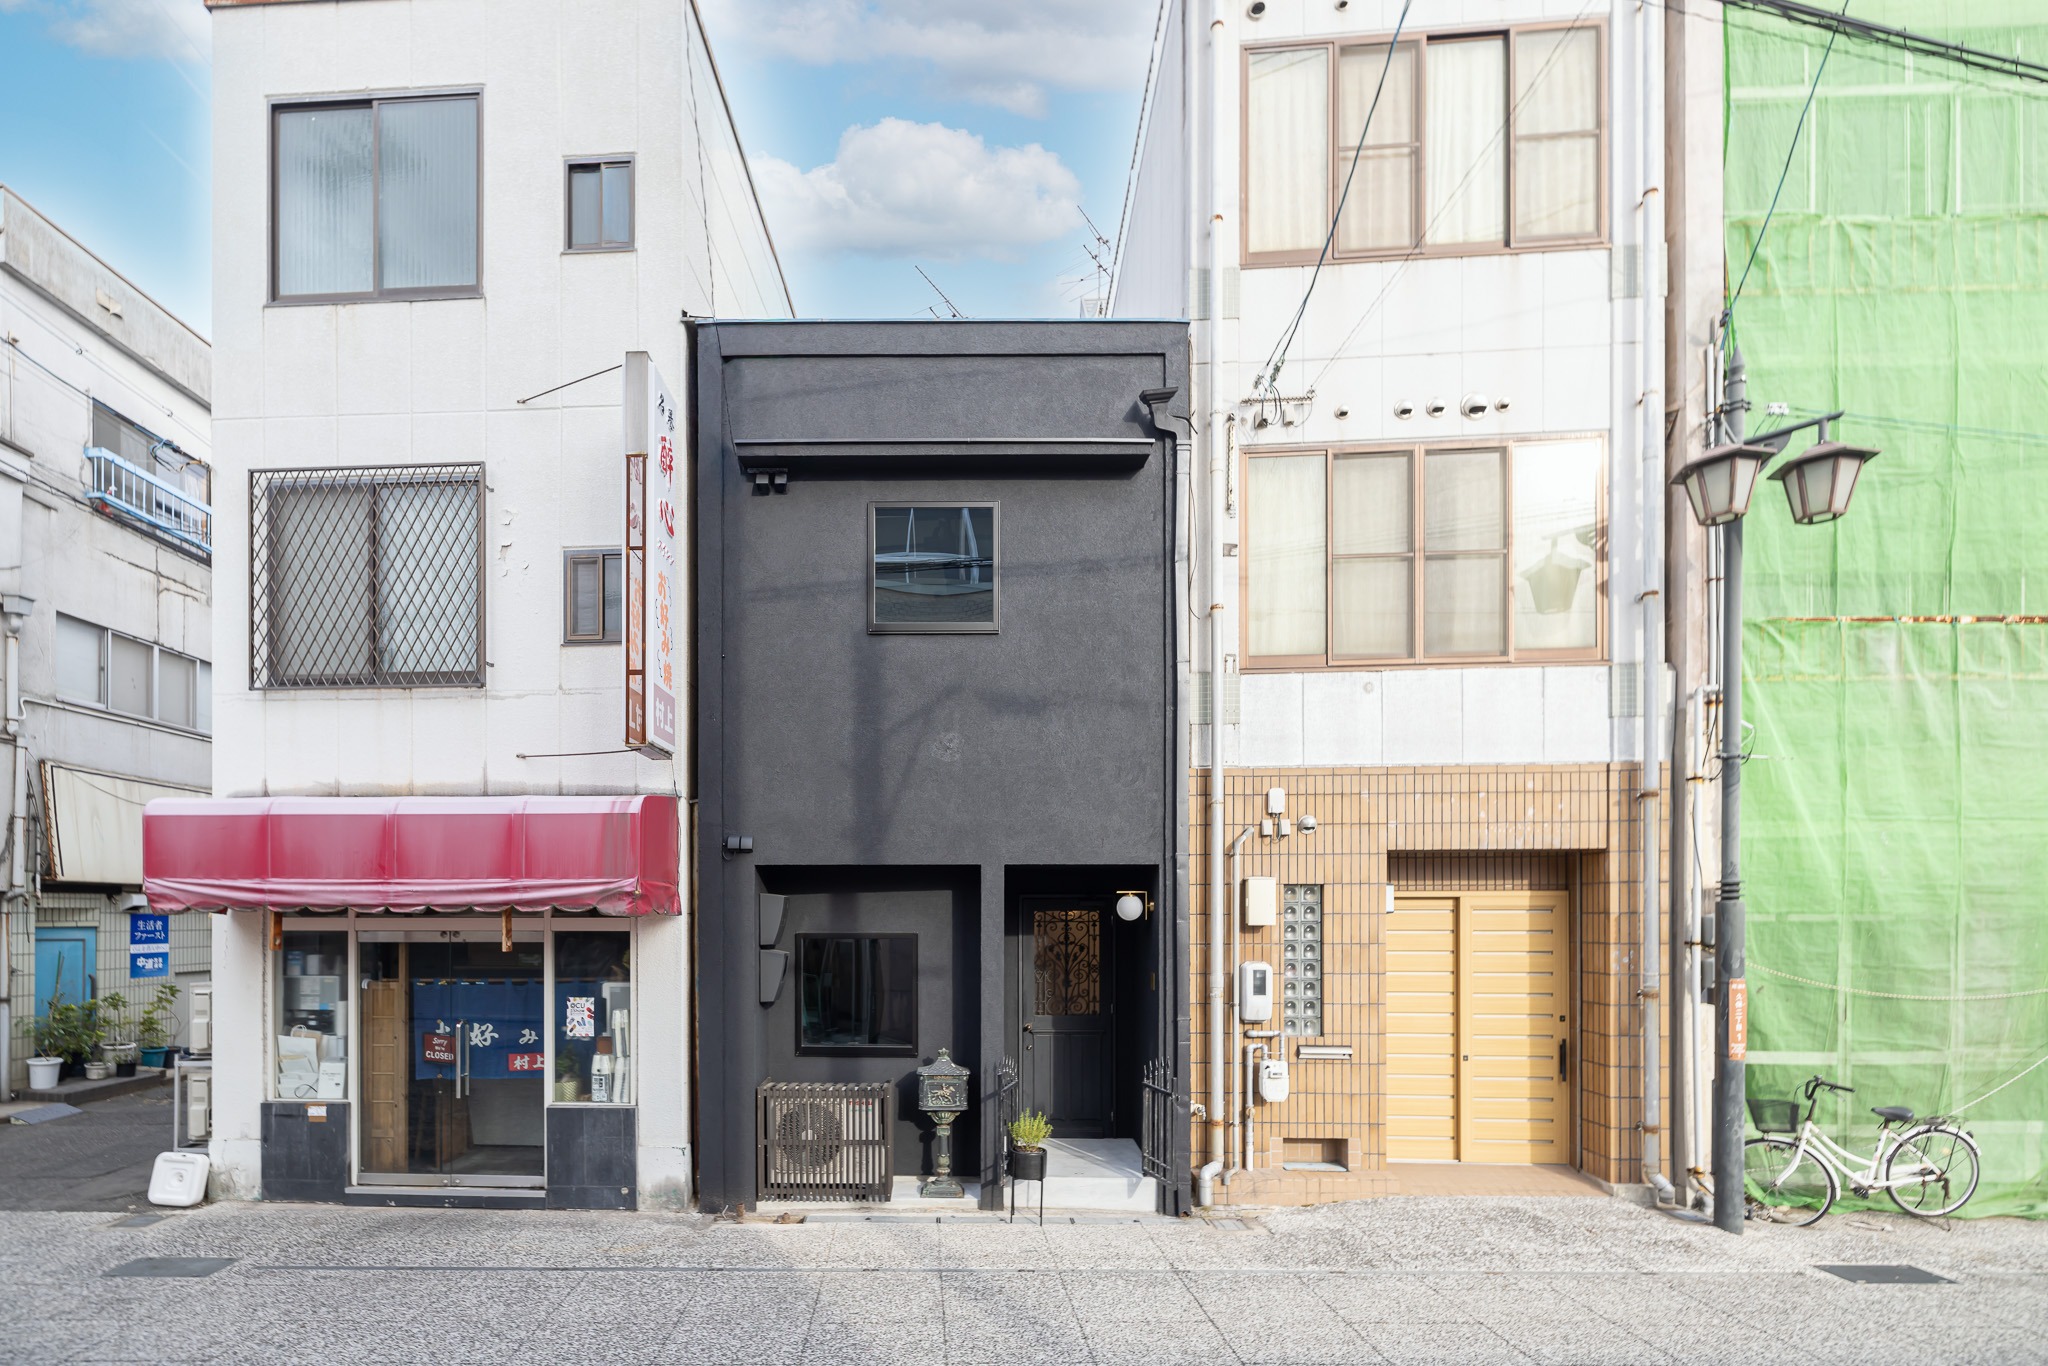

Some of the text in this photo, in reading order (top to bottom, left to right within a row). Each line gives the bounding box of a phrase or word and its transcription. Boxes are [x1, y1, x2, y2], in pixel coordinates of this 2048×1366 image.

[655, 697, 674, 735] 村上
[137, 919, 163, 931] 生活者
[134, 930, 166, 941] ファースト
[425, 1050, 454, 1061] CLOSED
[513, 1054, 545, 1070] 村上
